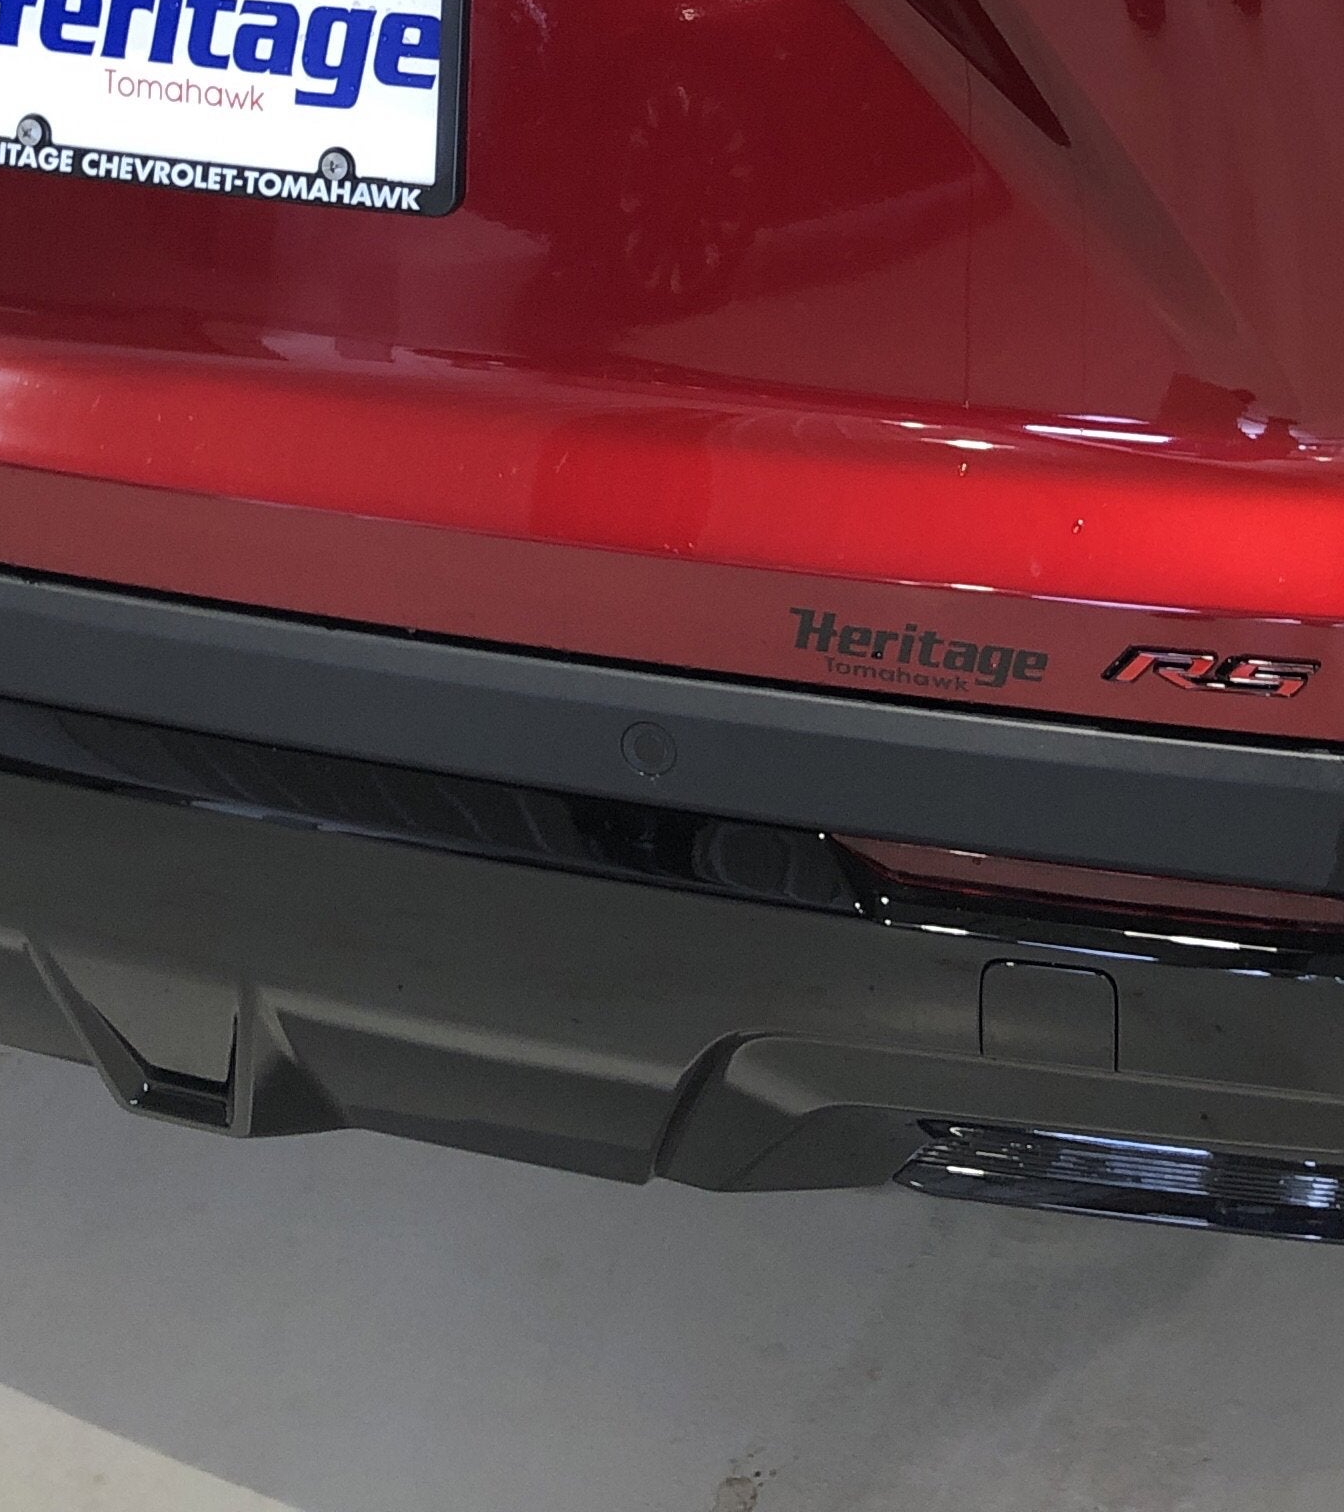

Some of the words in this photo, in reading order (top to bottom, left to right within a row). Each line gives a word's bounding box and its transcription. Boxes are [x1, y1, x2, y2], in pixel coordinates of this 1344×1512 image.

[104, 68, 265, 112] Tomahawk
[81, 152, 421, 211] CHEVROLET-TOMAHAWK
[789, 607, 1049, 688] Heritage
[823, 655, 970, 692] Tomahawk
[1100, 644, 1322, 698] RS
